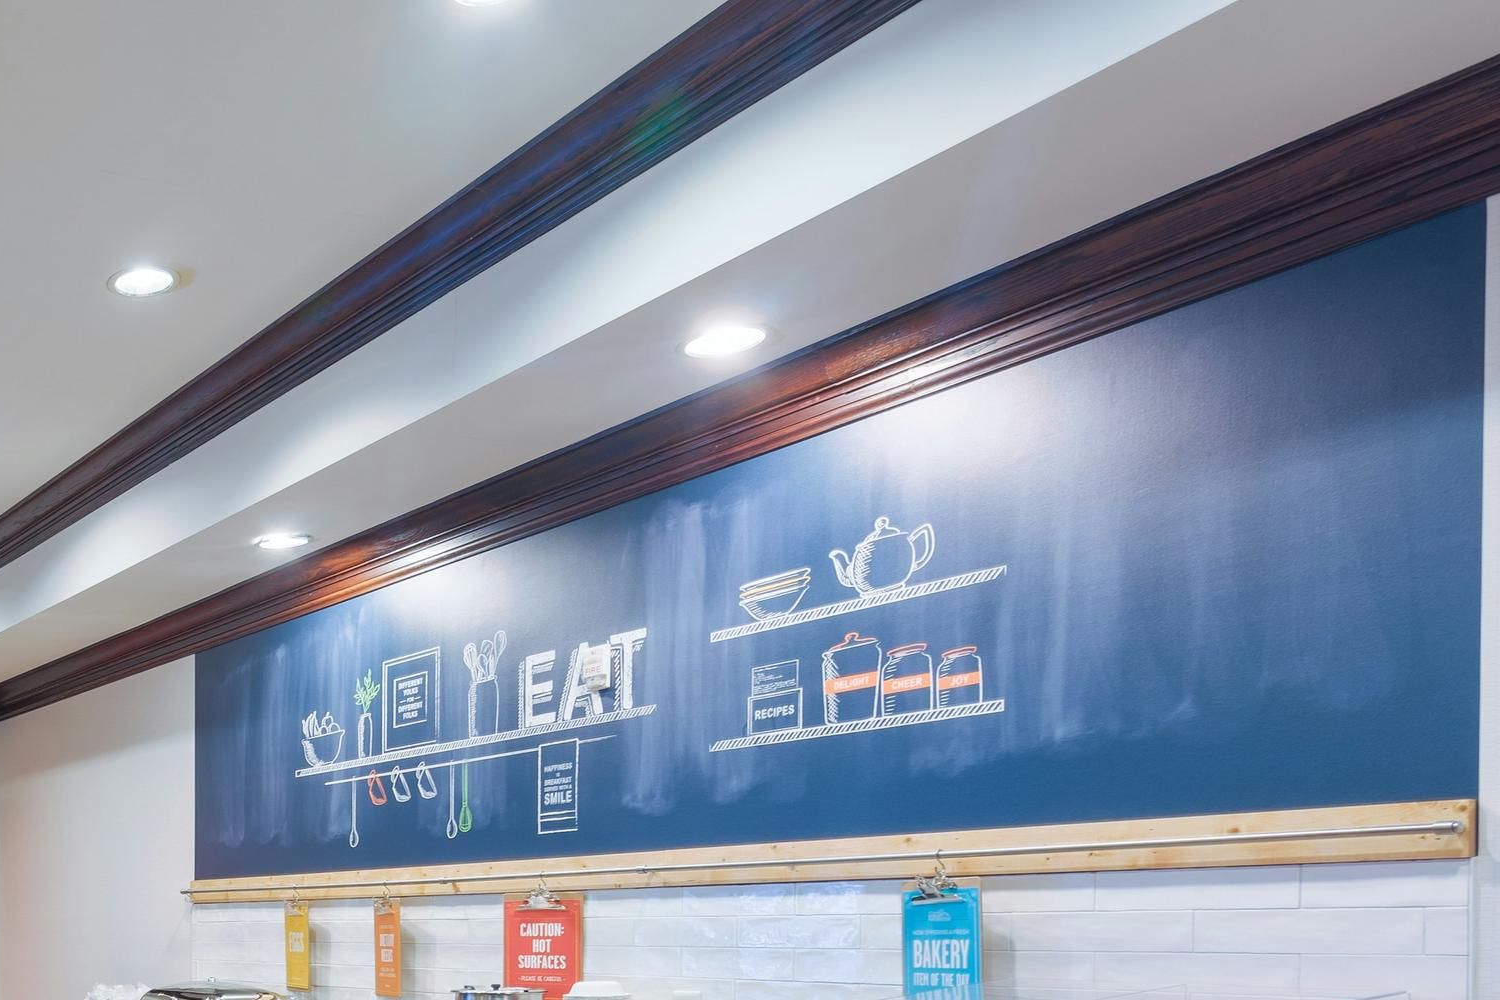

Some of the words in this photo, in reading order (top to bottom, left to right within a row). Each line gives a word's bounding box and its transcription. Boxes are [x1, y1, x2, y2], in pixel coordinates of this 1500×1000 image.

[523, 627, 647, 728] EAT
[834, 676, 870, 690] DELIGHT
[891, 677, 923, 690] CHEER
[951, 674, 970, 686] JOY
[754, 704, 795, 721] RECIPES
[544, 762, 572, 773] HAPPINESS
[544, 776, 572, 786] BREAKFAST
[544, 790, 572, 806] SMILE
[519, 922, 565, 937] CAUTION:
[532, 938, 552, 953] HOT
[518, 954, 567, 969] SURFACES
[913, 939, 970, 969] BAKERY
[913, 972, 929, 986] ITEM
[930, 972, 939, 986] OF
[941, 973, 954, 987] THE
[955, 973, 970, 986] DAY
